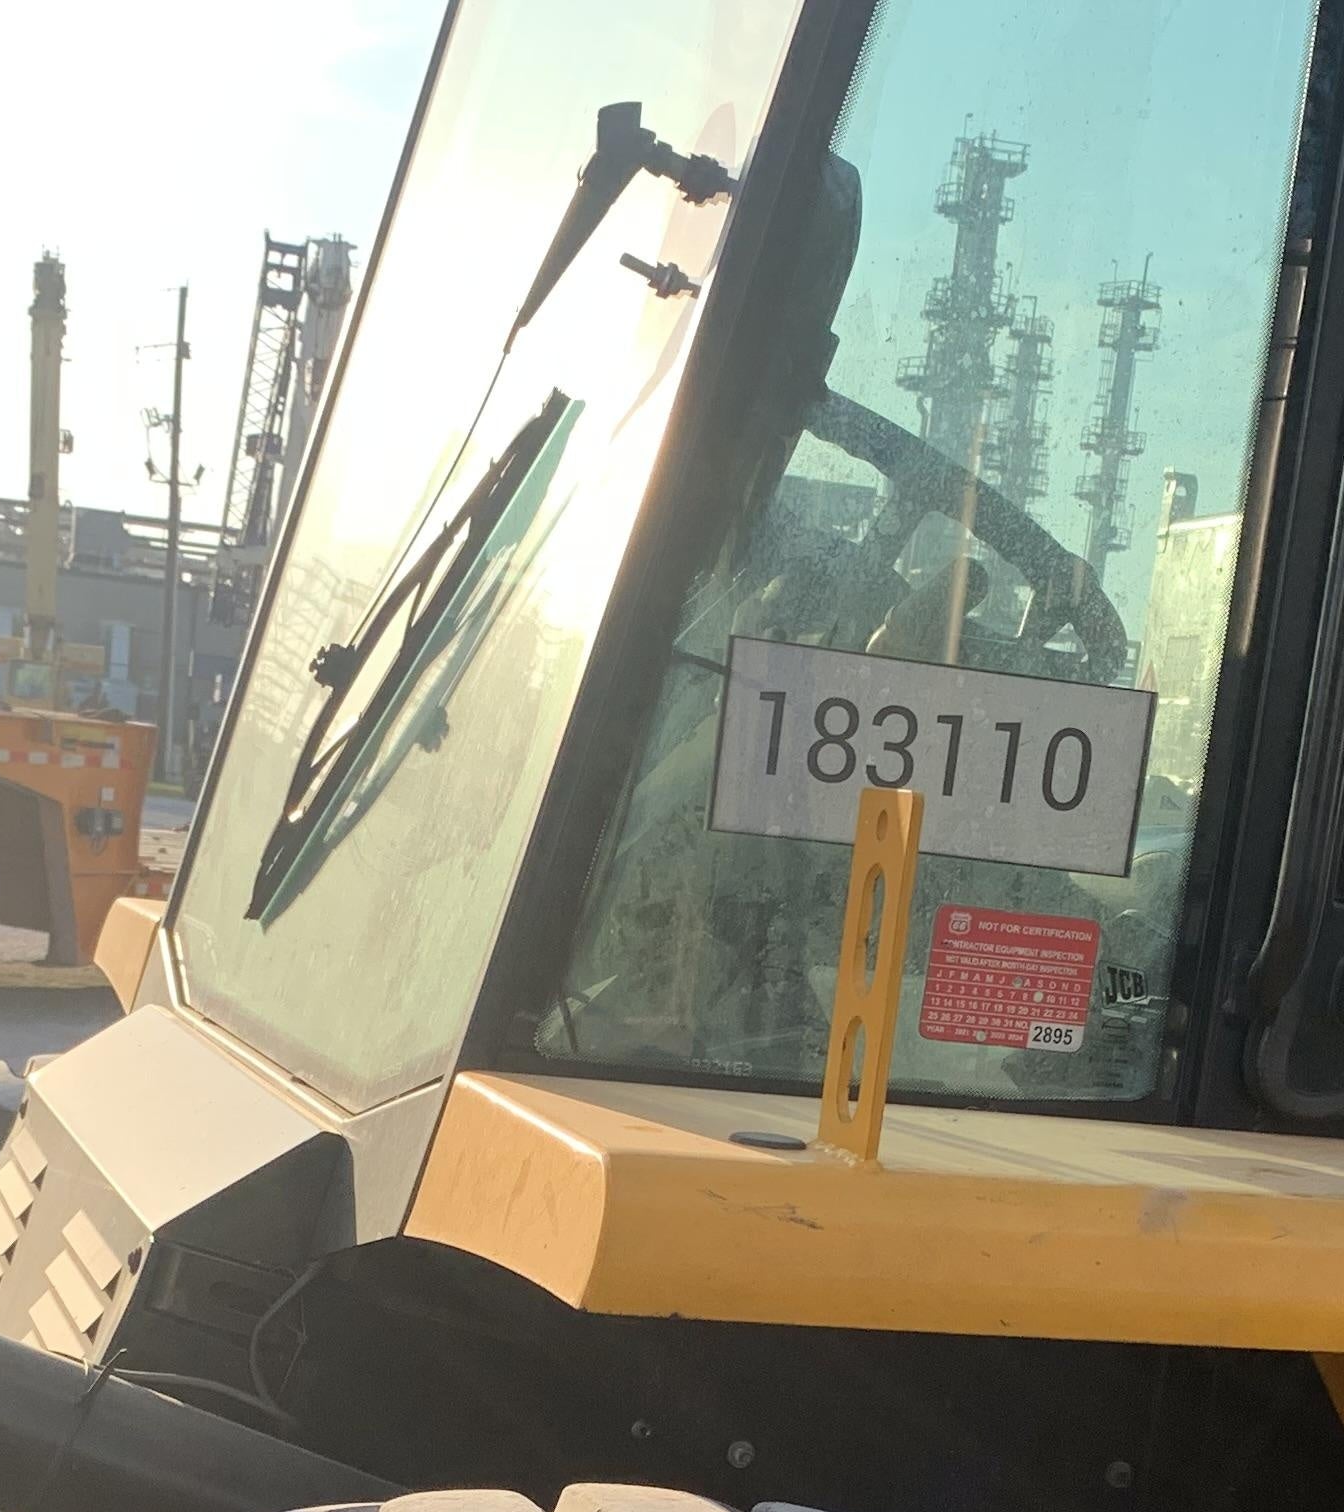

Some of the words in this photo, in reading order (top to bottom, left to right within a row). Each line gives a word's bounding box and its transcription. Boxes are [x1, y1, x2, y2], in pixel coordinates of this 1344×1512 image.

[757, 690, 1094, 811] 183110
[952, 921, 966, 930] 66
[978, 921, 997, 931] NOT
[1000, 923, 1020, 934] FOR
[1023, 926, 1092, 941] CERTIFICATION
[943, 939, 994, 952] CONTRACTOR
[995, 944, 1038, 957] EQUIPMENT
[1040, 949, 1084, 961] INSPECTION
[948, 970, 954, 978] F
[960, 972, 968, 980] M
[973, 973, 980, 981] A
[986, 974, 993, 982] M
[1000, 976, 1005, 984] J
[1024, 978, 1031, 987] A
[1038, 979, 1044, 988] S
[1049, 980, 1056, 989] O
[1061, 982, 1069, 990] N
[1074, 983, 1080, 992] D
[1039, 964, 1078, 976] INSPECTION
[1105, 966, 1145, 1005] JCB
[1032, 1025, 1073, 1045] 2895
